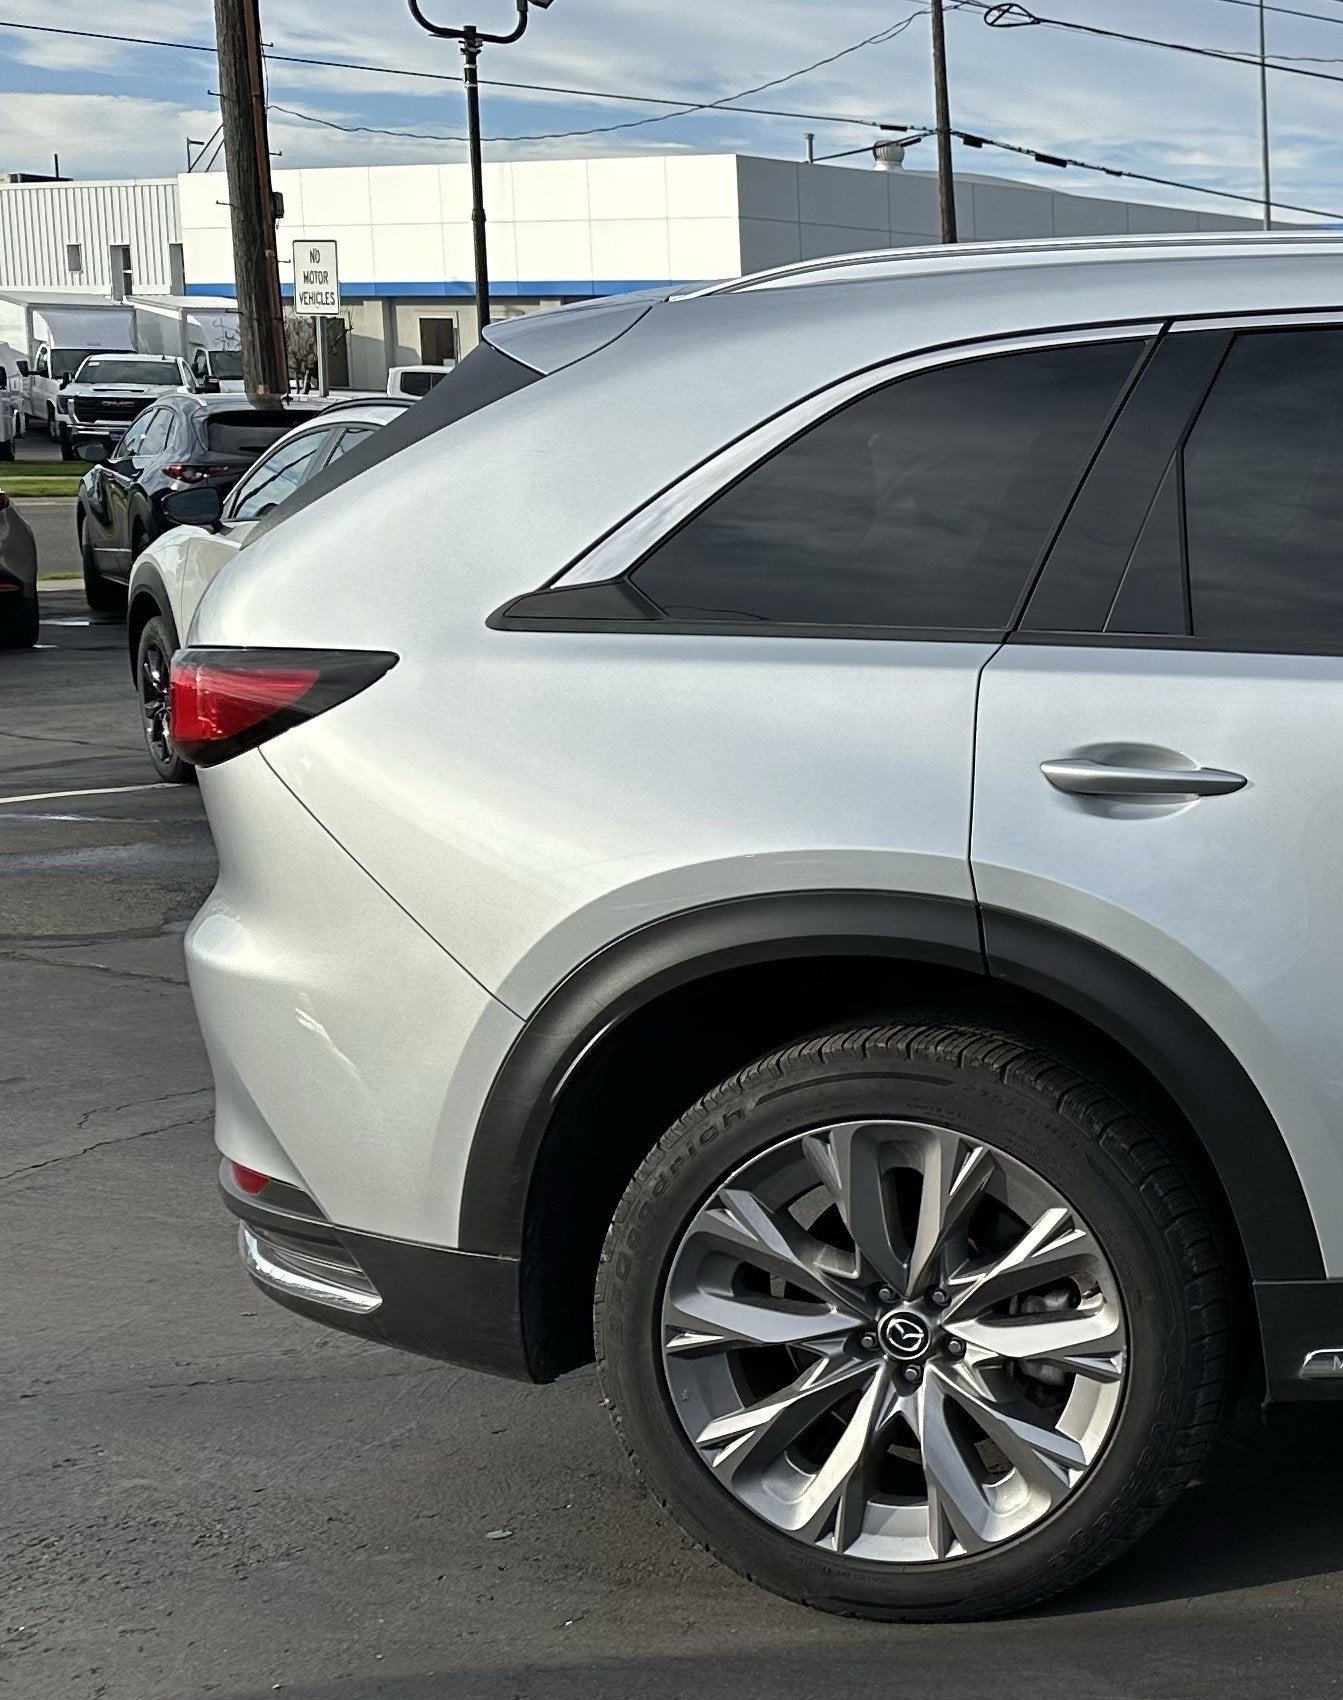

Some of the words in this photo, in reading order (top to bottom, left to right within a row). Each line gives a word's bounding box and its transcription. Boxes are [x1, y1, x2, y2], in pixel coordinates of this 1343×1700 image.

[310, 248, 321, 263] NO
[303, 270, 329, 284] MOTOR
[299, 291, 335, 305] VEHICLES
